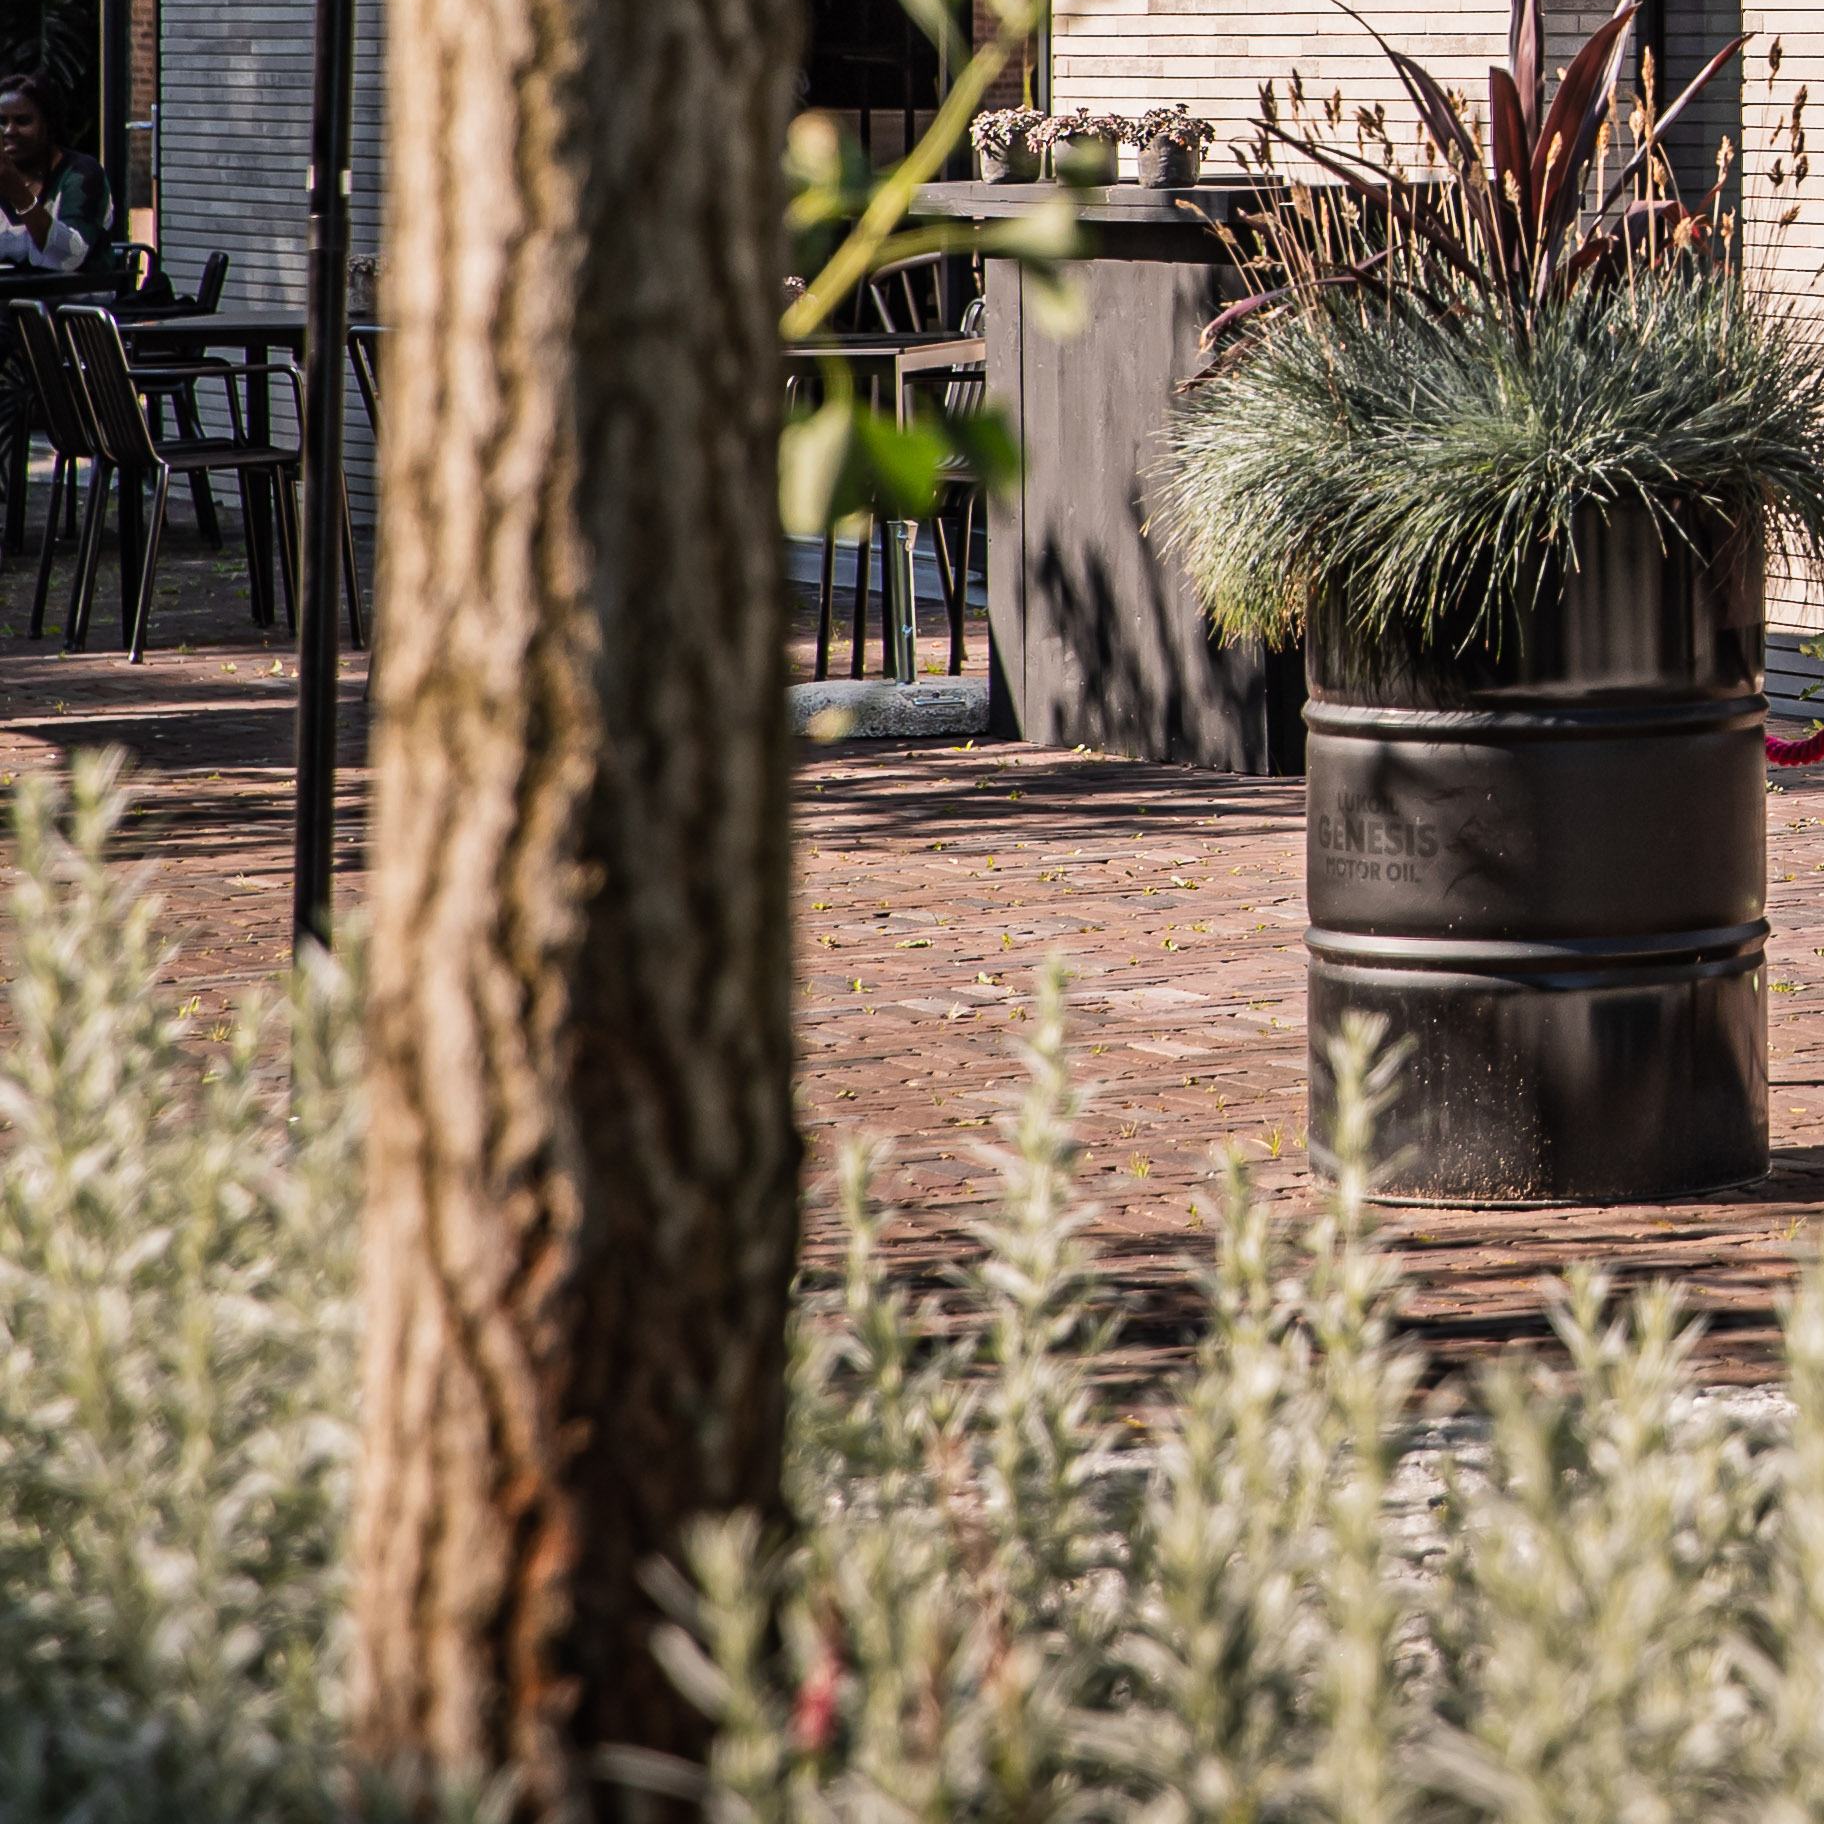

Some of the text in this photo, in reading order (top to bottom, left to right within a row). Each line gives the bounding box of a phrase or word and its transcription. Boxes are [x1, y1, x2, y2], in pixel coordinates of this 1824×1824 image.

[1318, 814, 1440, 858] GENESIS
[1326, 856, 1422, 883] MOTOR OIL
